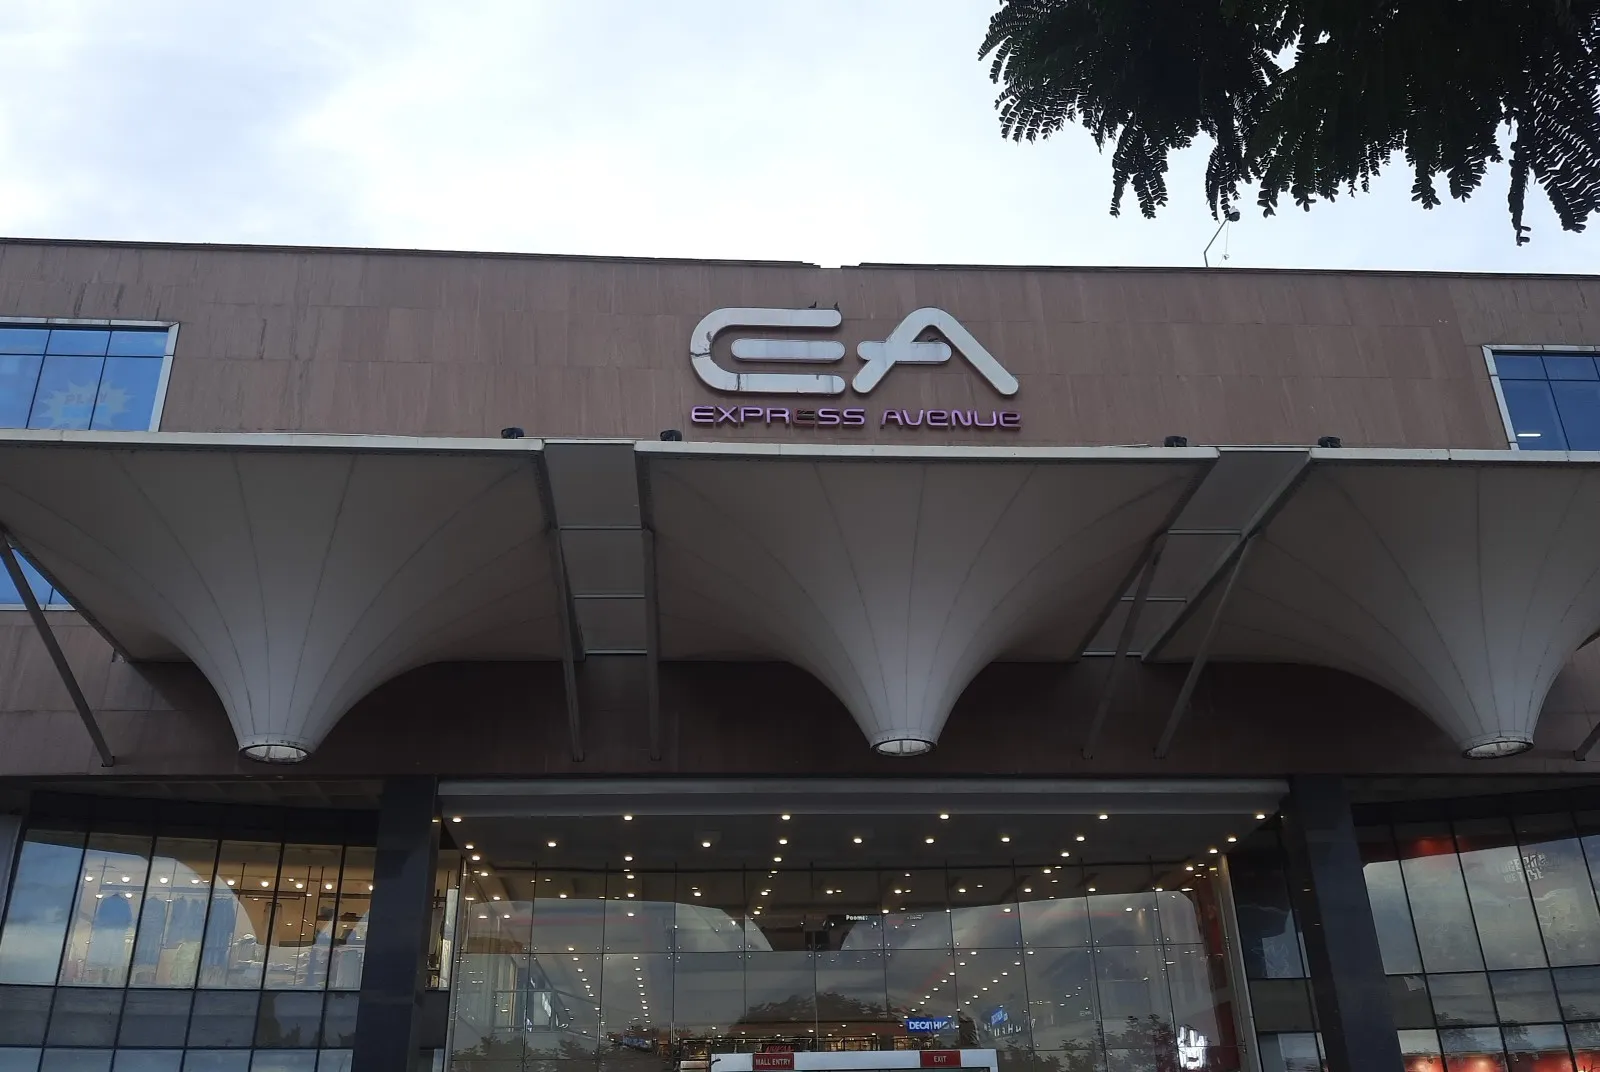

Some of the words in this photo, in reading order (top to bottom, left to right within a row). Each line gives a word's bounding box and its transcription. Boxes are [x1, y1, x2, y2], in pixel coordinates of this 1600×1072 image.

[689, 306, 1020, 396] EA
[691, 404, 867, 427] EXPRESS
[755, 1058, 771, 1066] MALL
[772, 1058, 790, 1066] ENTRY
[933, 1055, 947, 1063] EXIT
